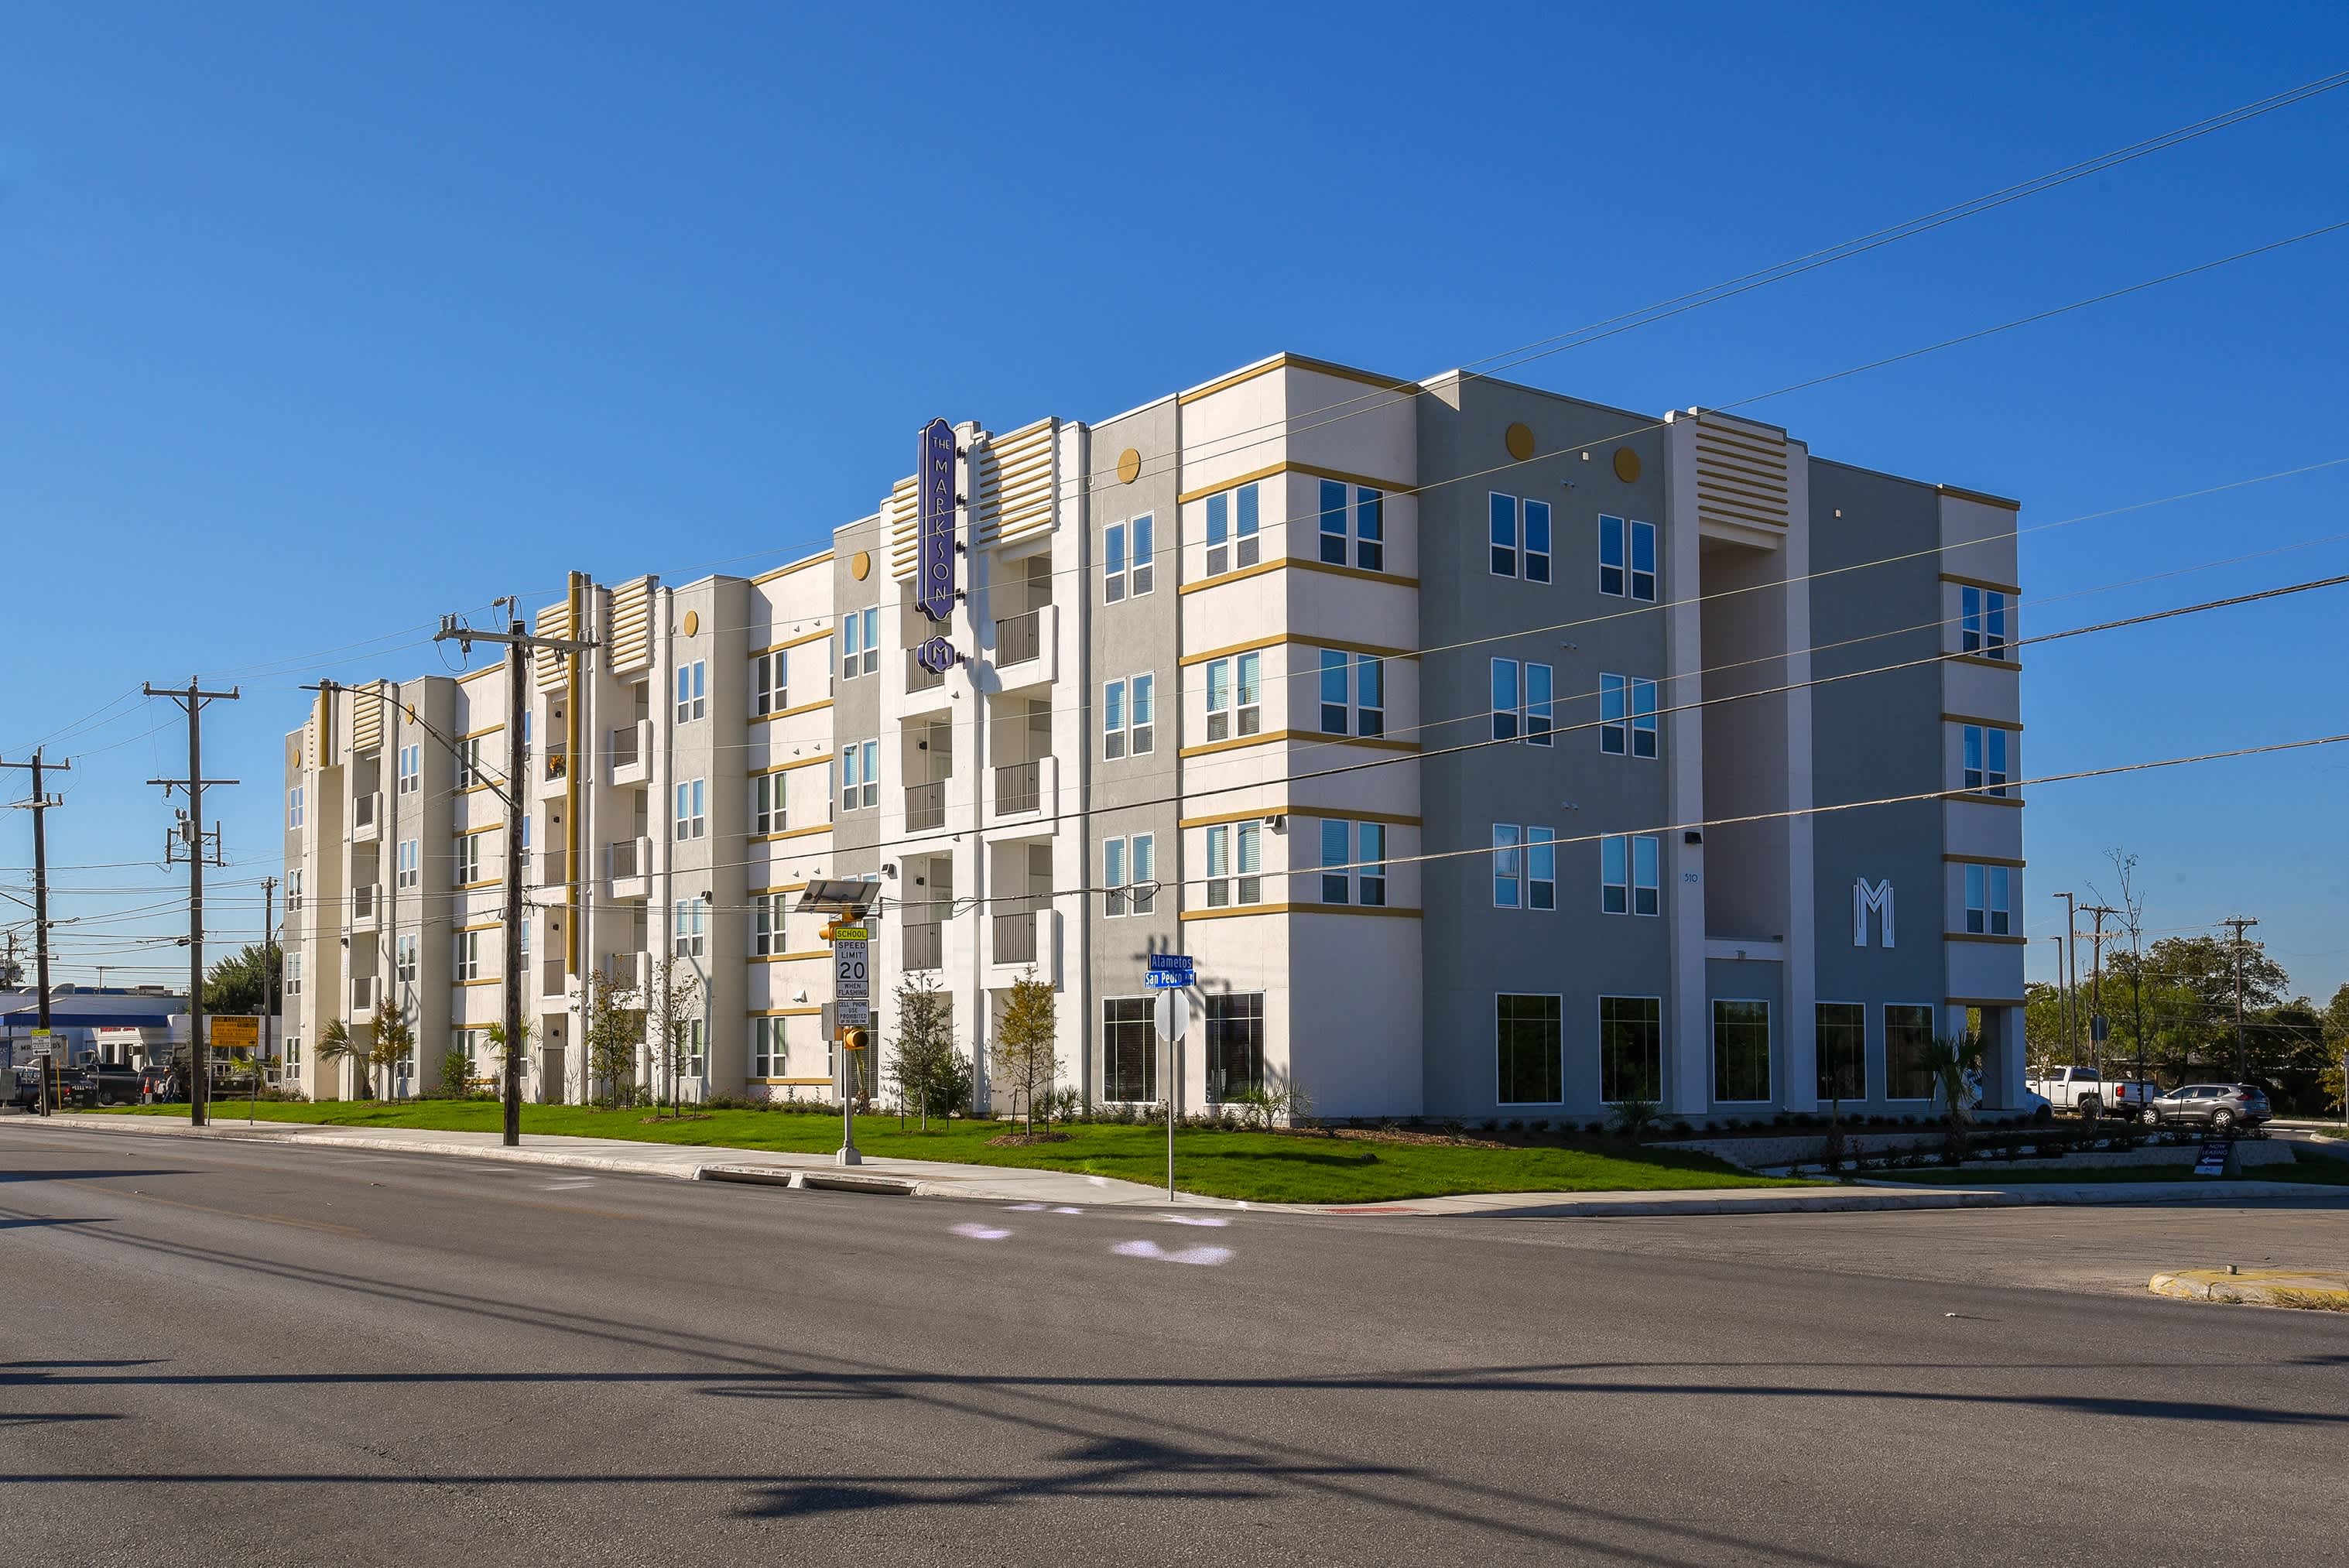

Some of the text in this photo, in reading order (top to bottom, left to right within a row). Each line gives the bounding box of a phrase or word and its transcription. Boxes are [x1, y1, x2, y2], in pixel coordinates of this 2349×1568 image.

[932, 437, 950, 450] THE
[933, 459, 949, 602] MARKSON
[933, 645, 949, 664] M
[1684, 873, 1698, 882] 510
[1853, 877, 1895, 948] M
[1151, 955, 1192, 968] Alametos
[840, 962, 865, 979] 20
[1145, 973, 1159, 984] San
[1161, 971, 1183, 984] Pedro
